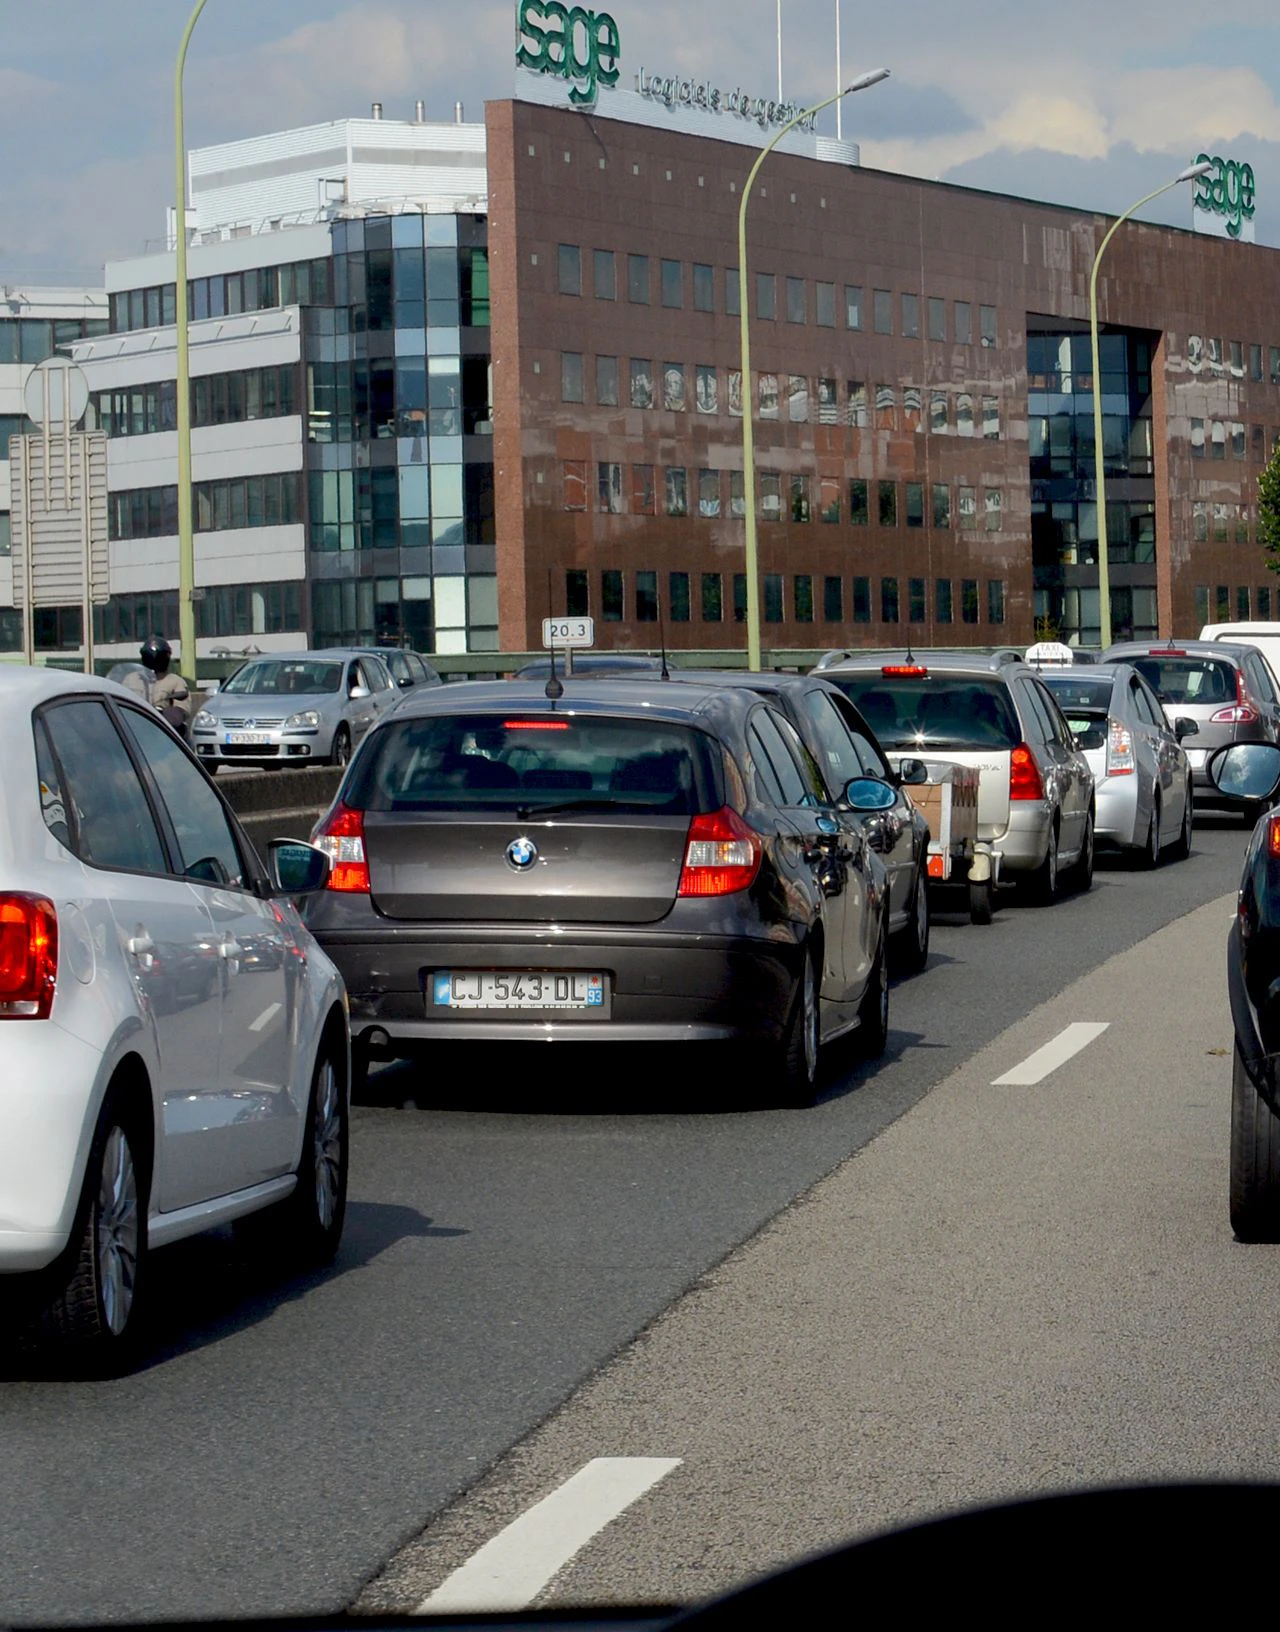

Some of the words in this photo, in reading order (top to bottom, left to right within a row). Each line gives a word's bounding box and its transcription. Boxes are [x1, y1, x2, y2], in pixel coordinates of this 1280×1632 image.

[516, 0, 621, 104] sage
[637, 67, 720, 107] Logiciels
[727, 87, 750, 116] de
[1194, 153, 1255, 238] sage
[551, 624, 586, 637] 20.3
[451, 975, 585, 1002] CJ-543-DL
[587, 989, 602, 1003] 93
